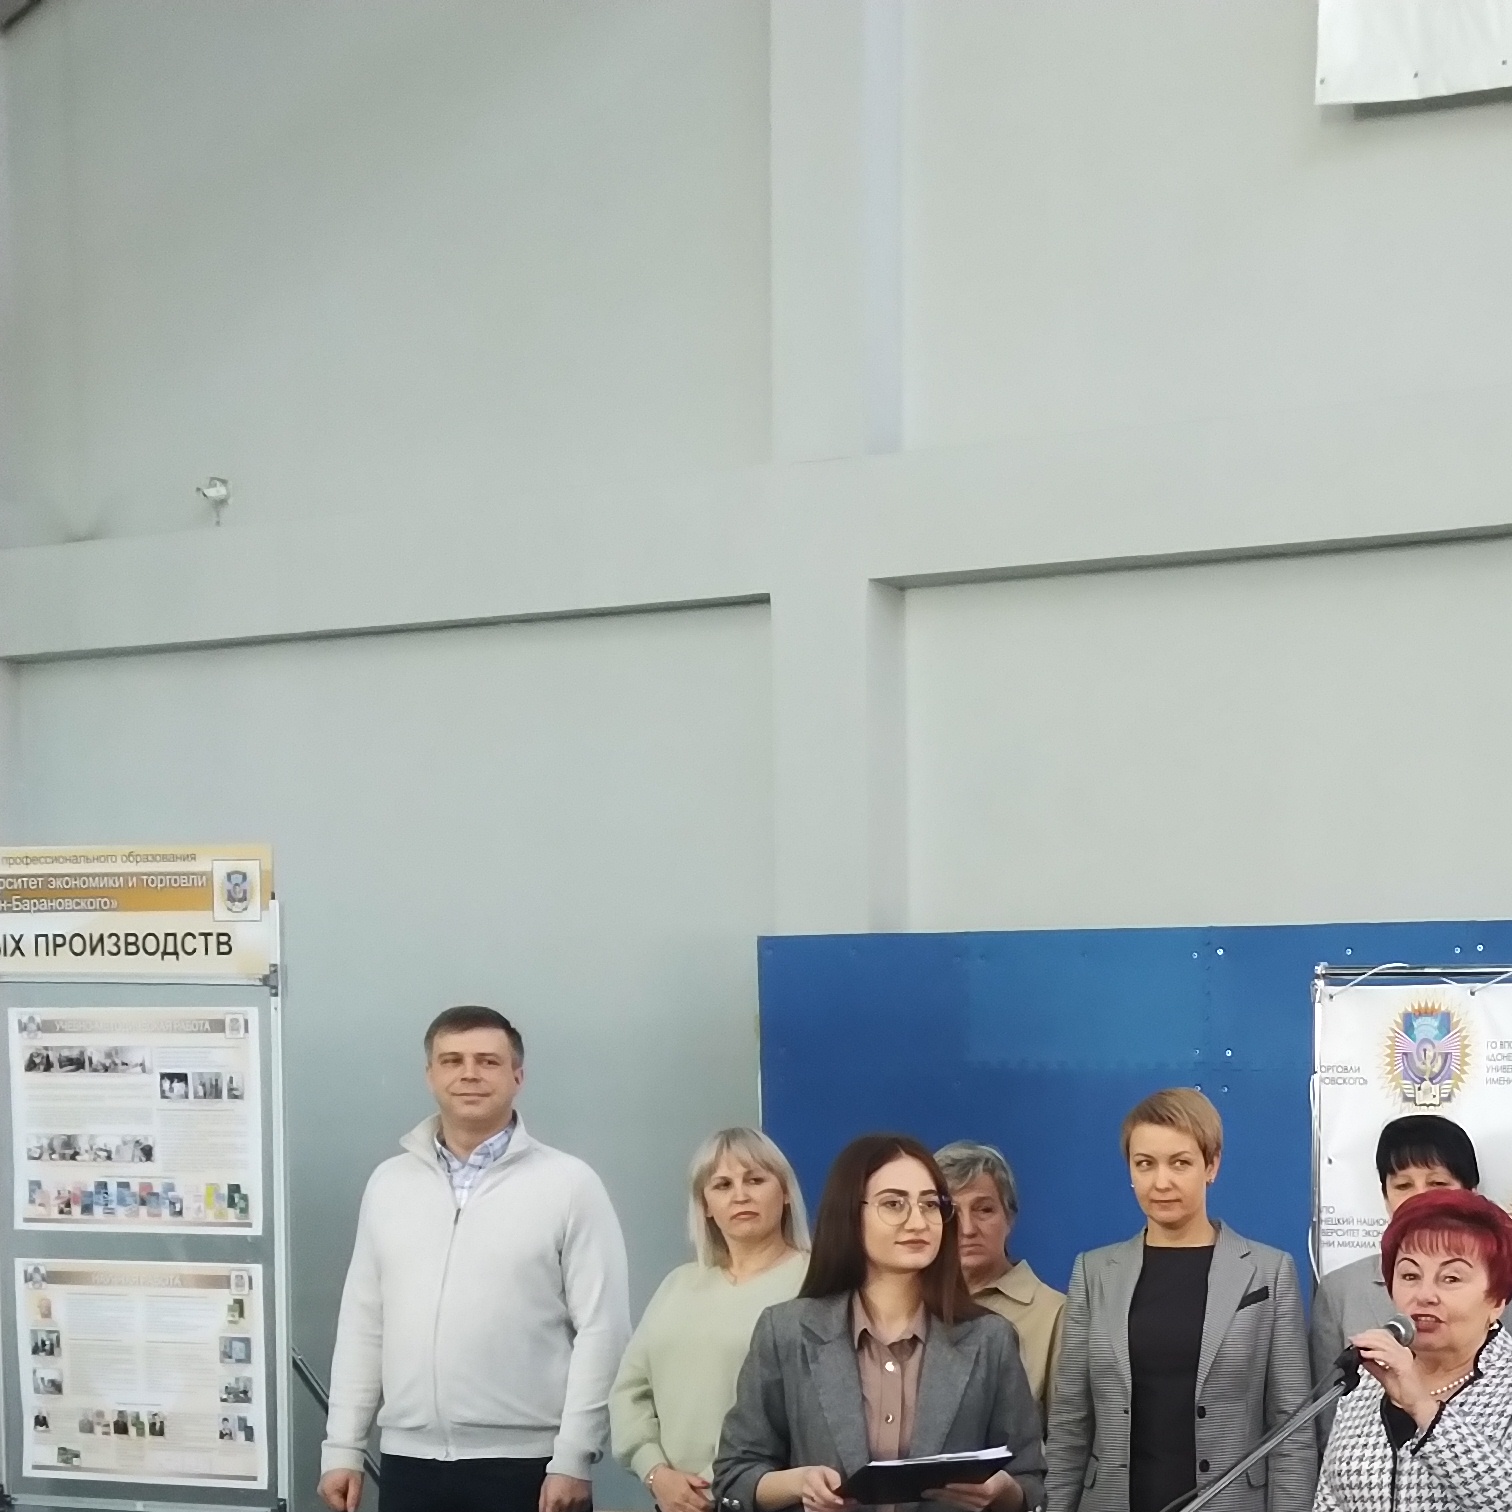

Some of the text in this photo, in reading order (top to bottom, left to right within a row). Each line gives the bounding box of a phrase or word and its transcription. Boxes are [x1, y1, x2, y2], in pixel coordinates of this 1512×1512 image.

[121, 851, 197, 865] образования
[47, 876, 123, 889] экономики
[128, 876, 137, 887] и
[142, 875, 207, 891] торговли
[35, 932, 233, 961] ПРОИЗВОДСТВ
[1486, 1041, 1498, 1049] ГО
[1320, 1064, 1361, 1073] ОРГОВЛИ
